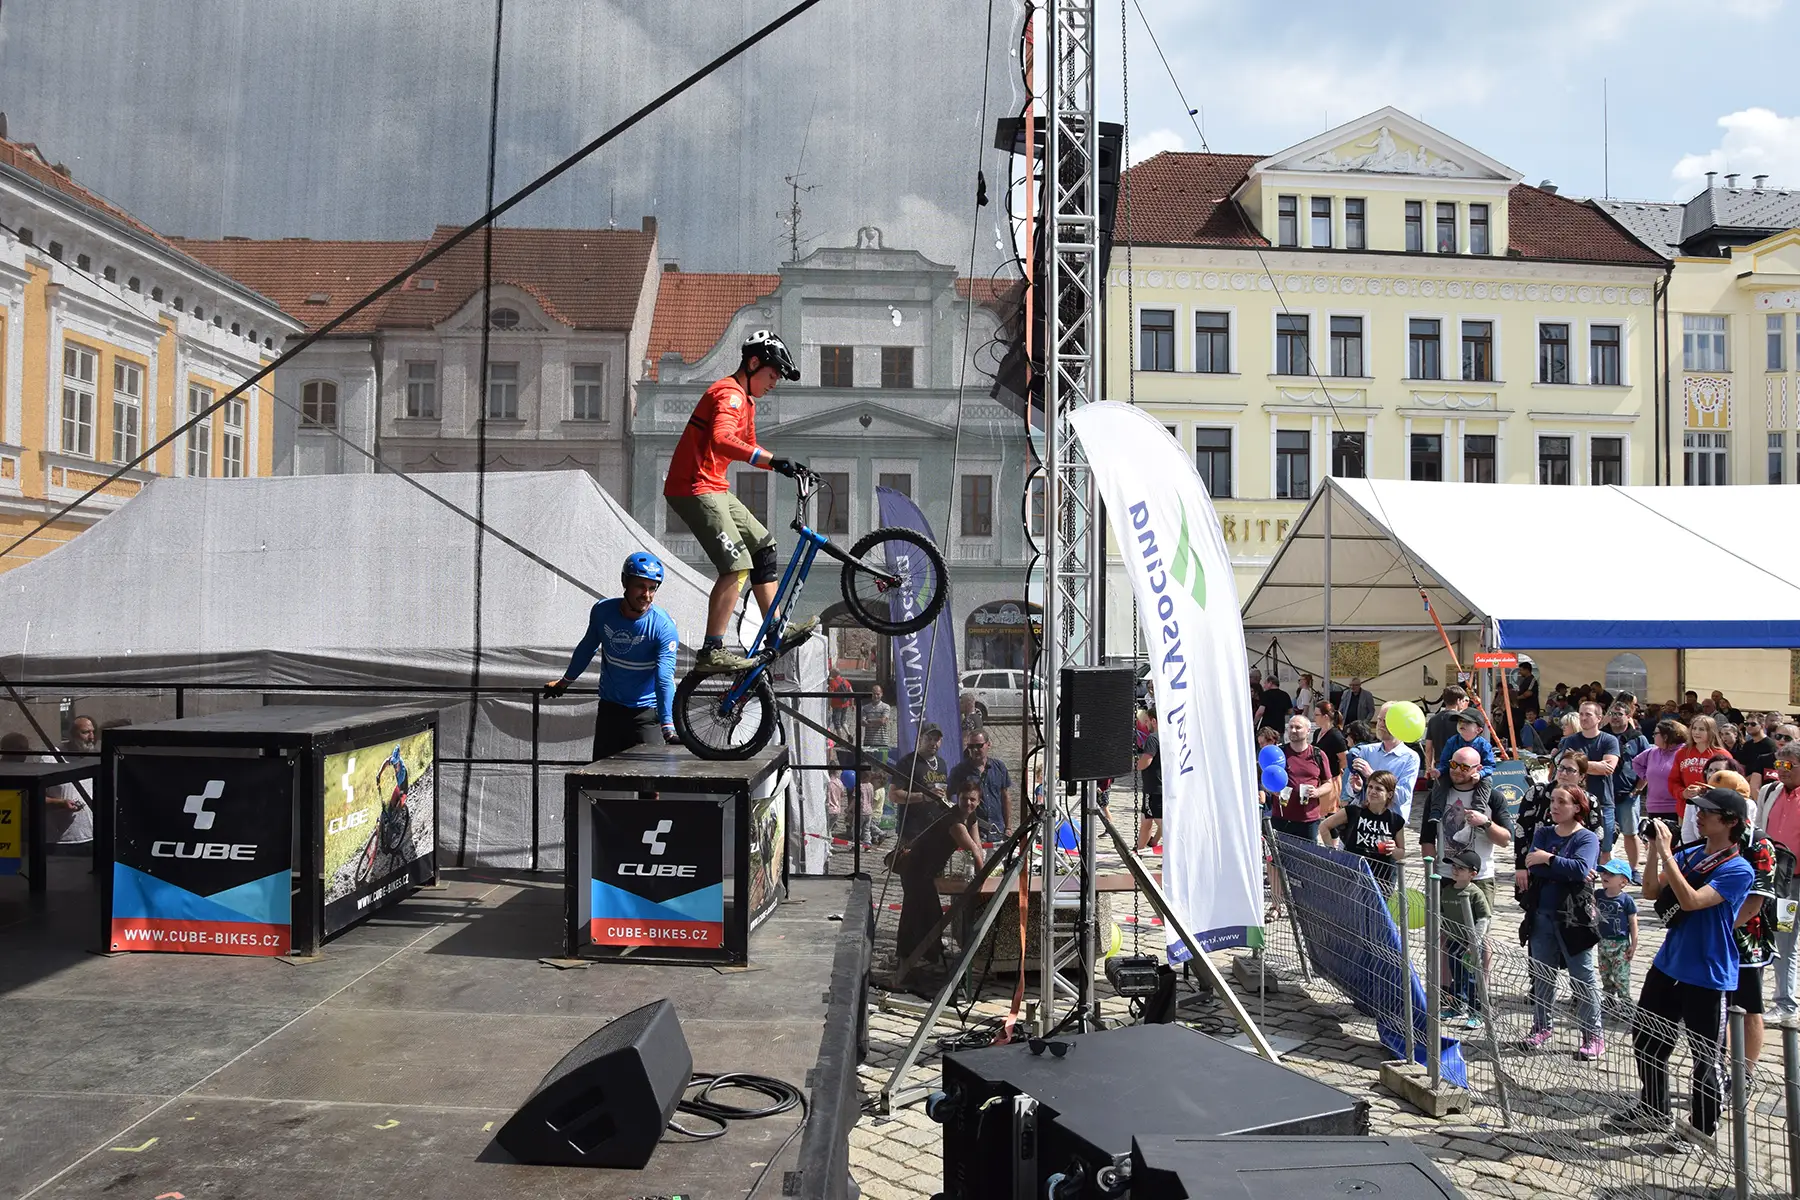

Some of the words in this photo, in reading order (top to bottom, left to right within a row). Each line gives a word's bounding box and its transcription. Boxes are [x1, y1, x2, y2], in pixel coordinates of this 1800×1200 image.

[327, 807, 369, 835] CUBE
[151, 840, 258, 861] CUBE
[617, 863, 698, 878] CUBE
[124, 929, 281, 947] WWW.CUBE-BIKES.CZ
[607, 927, 709, 940] CUBE-BIKES.CZ
